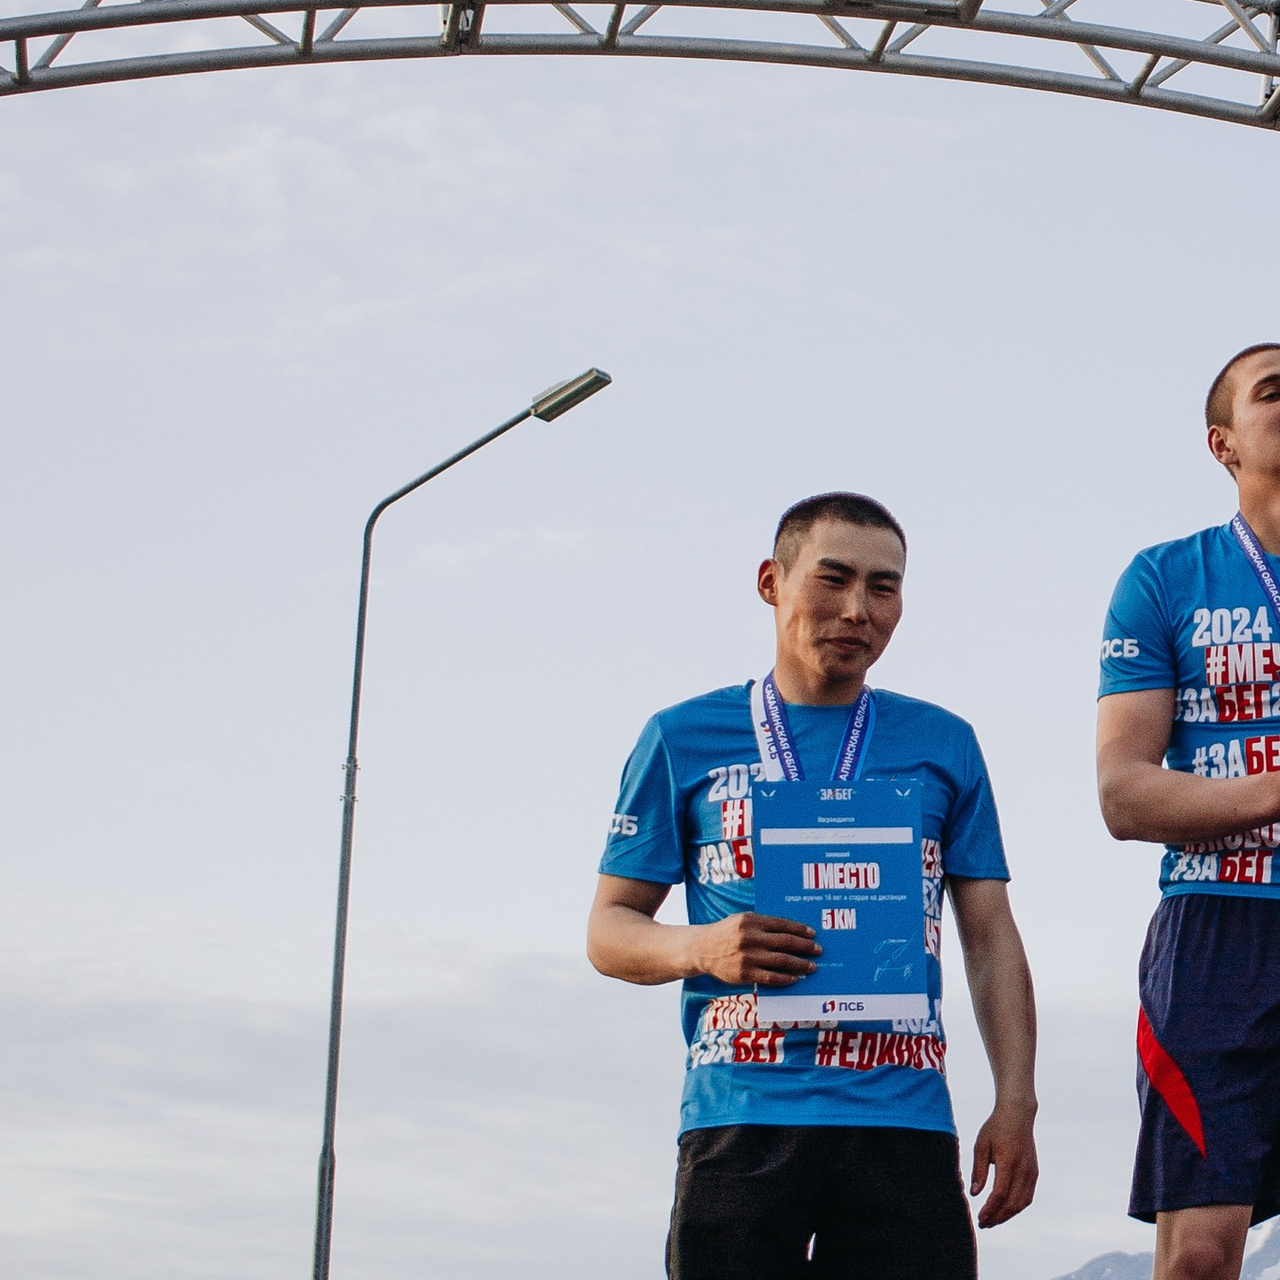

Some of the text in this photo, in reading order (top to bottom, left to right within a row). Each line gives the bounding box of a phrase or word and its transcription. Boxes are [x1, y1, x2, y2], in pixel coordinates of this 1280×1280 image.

[1232, 517, 1266, 572] САХАЛИНСКАЯ
[1191, 606, 1273, 648] 2024
[764, 683, 790, 750] САХАЛИНСКАЯ
[817, 862, 881, 890] МЕСТО
[821, 908, 857, 930] 5 КМ
[838, 1001, 865, 1012] ПСБ
